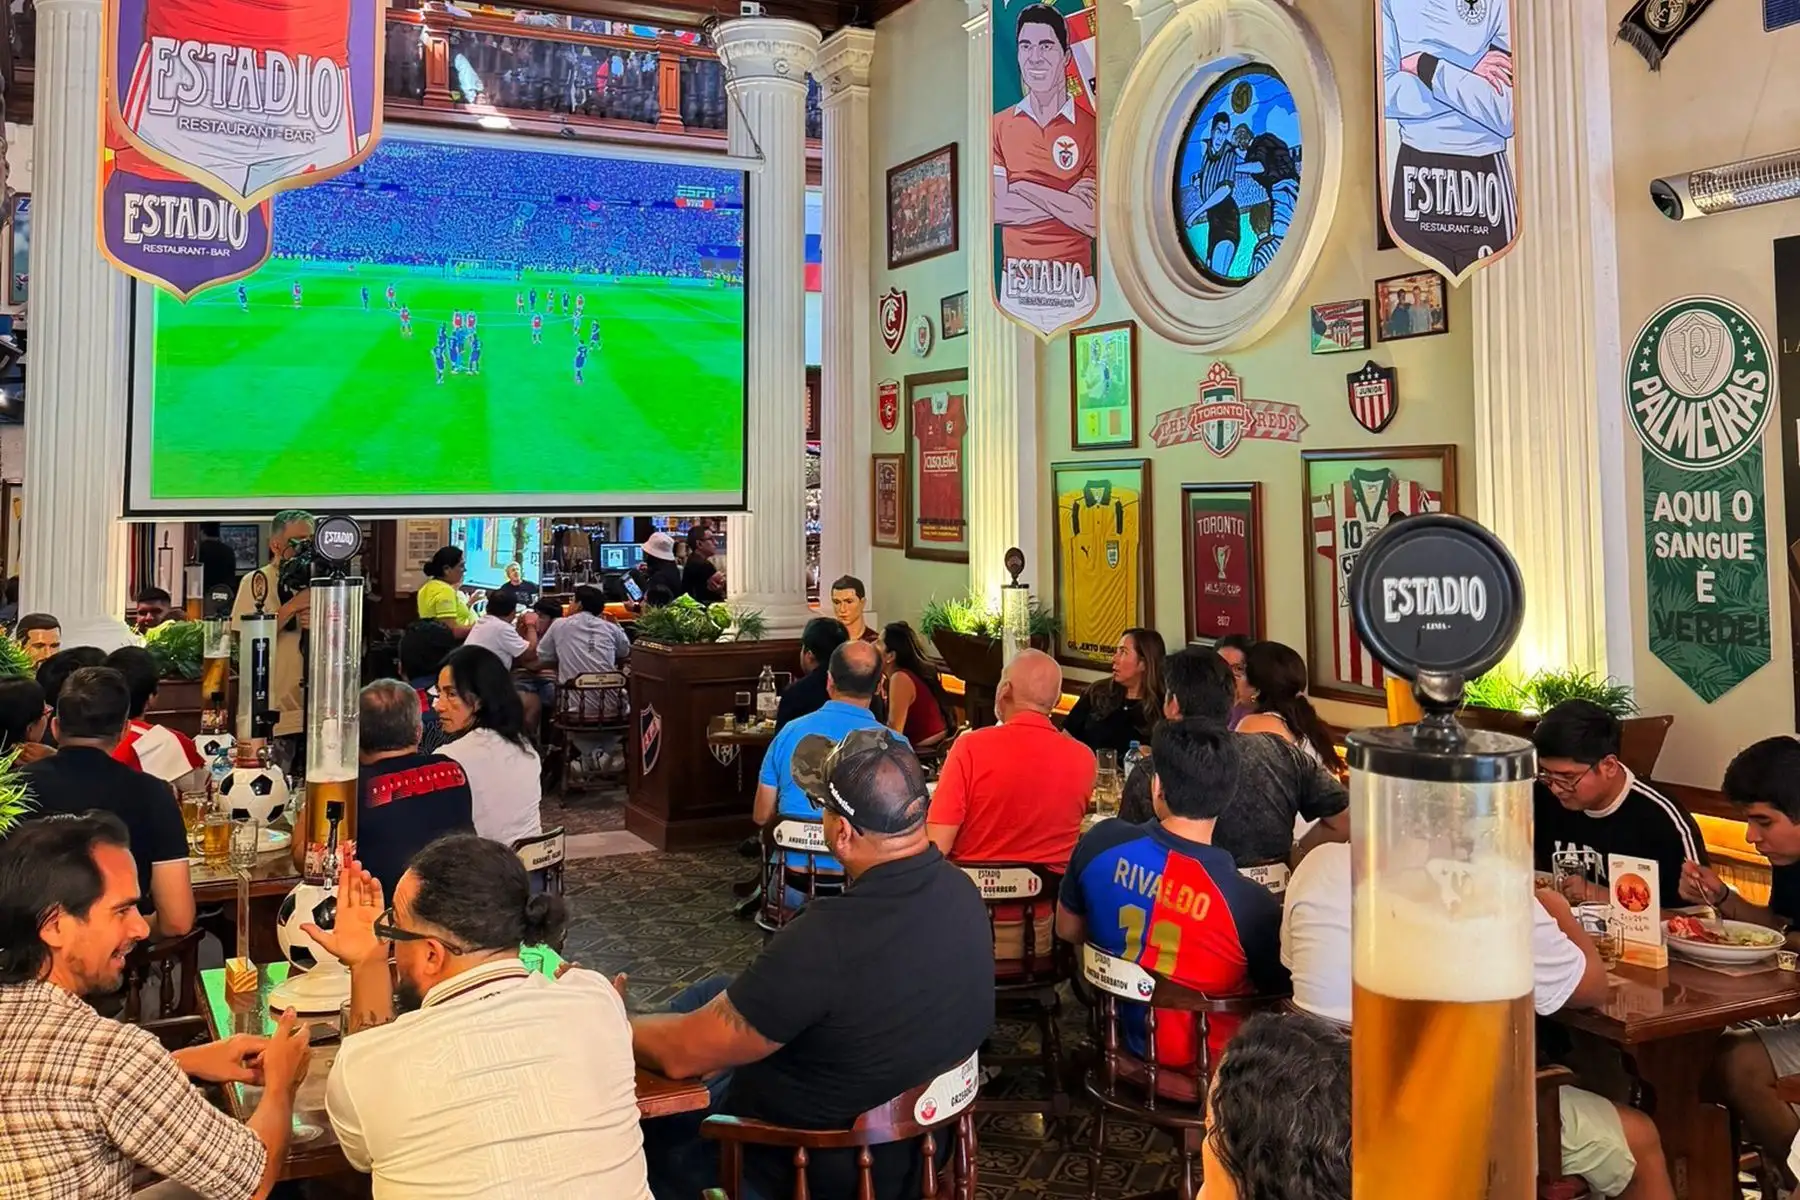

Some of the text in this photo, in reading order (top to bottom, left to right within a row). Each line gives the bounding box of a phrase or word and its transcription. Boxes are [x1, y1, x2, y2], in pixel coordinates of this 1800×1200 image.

[149, 35, 343, 133] ESTADIO
[1402, 165, 1502, 228] ESTADIO
[123, 192, 249, 250] ESTADIO
[1006, 257, 1086, 302] ESTADIO
[1360, 386, 1383, 395] JUNIOR
[1160, 411, 1297, 436] THE REDS
[1197, 405, 1243, 419] TORONTO
[1632, 369, 1767, 460] PALMEIRAS
[1197, 515, 1245, 538] TORONTO
[1653, 489, 1754, 527] AQUI O
[323, 530, 354, 546] ESTADIO
[1342, 520, 1363, 549] 10
[1654, 531, 1755, 561] SANGUE
[1382, 575, 1488, 623] ESTADIO
[1696, 563, 1717, 604] É
[1113, 857, 1211, 921] RIVALDO
